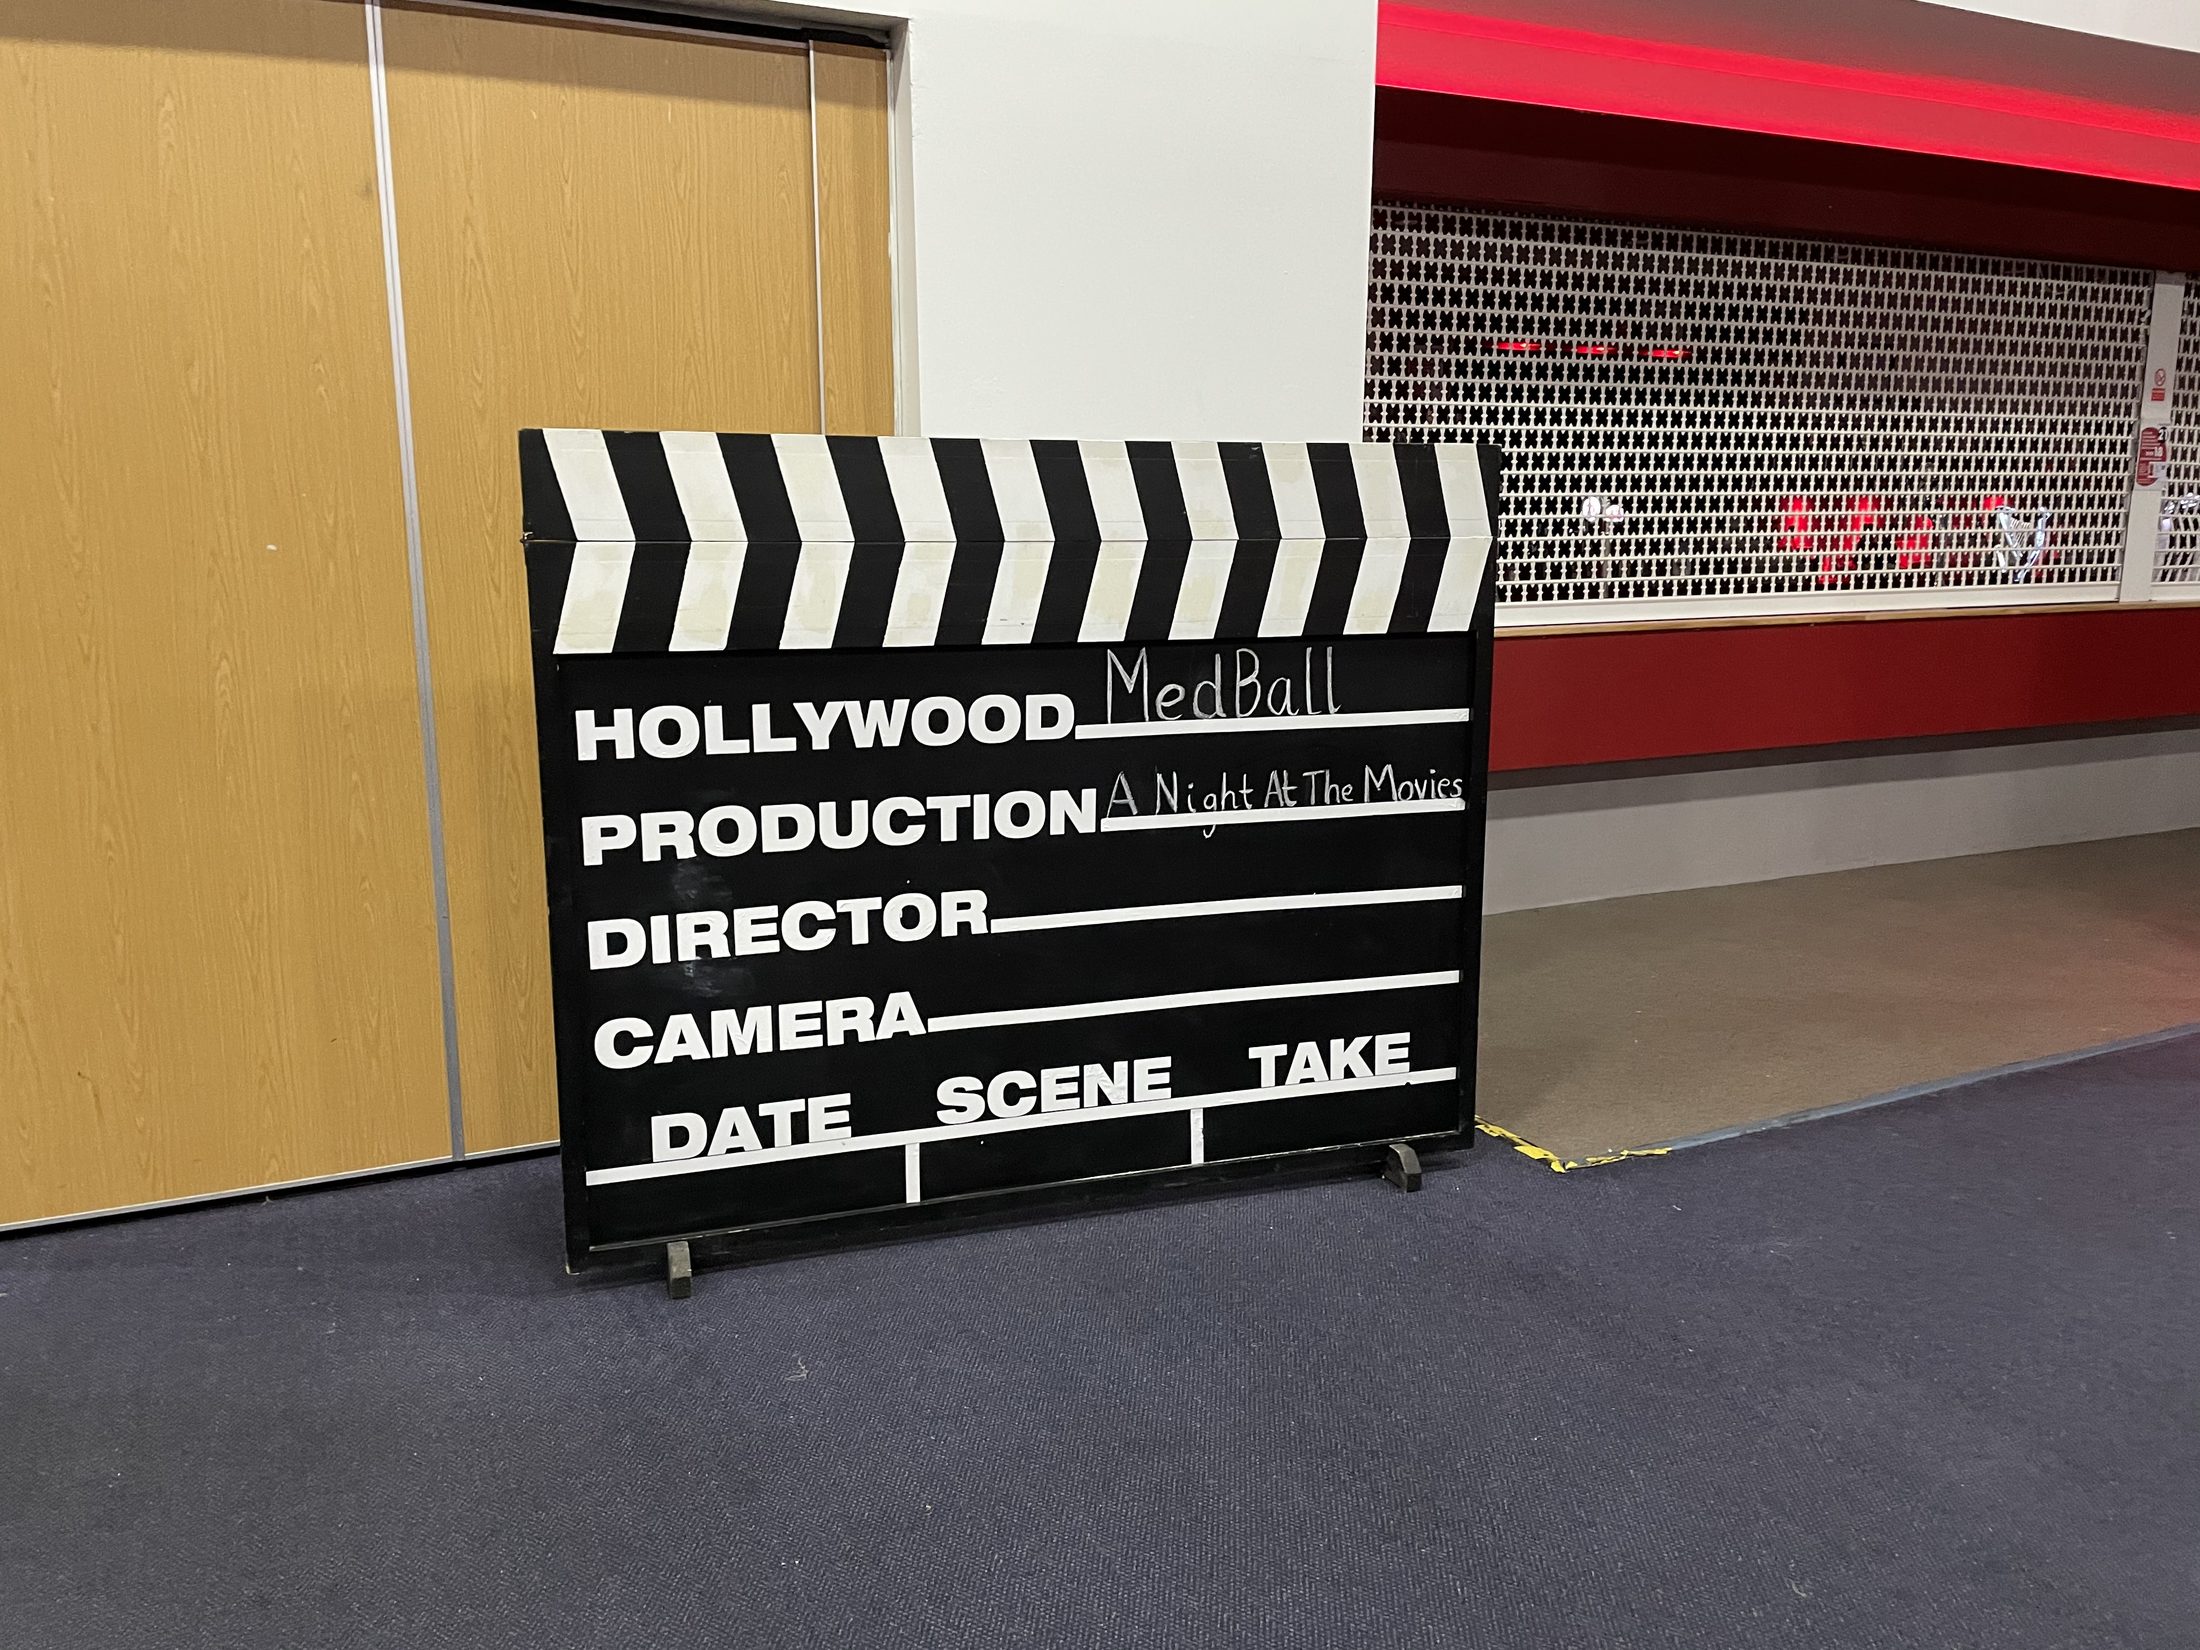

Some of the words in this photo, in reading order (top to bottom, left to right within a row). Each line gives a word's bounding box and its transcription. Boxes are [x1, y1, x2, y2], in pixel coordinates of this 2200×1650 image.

[1106, 646, 1342, 723] MedBall
[575, 694, 1075, 760] HOLLYWOOD
[582, 788, 1097, 866] PRODUCTION
[1106, 771, 1138, 818] A
[1155, 769, 1254, 838] Night
[1264, 769, 1298, 807] At
[1302, 768, 1355, 806] The
[1364, 764, 1463, 803] Movies
[588, 890, 989, 970] DIRECTOR
[595, 991, 927, 1069] CAMERA
[1248, 1032, 1411, 1088] TAKE
[651, 1093, 851, 1162] DATE
[936, 1056, 1172, 1125] SCENE
